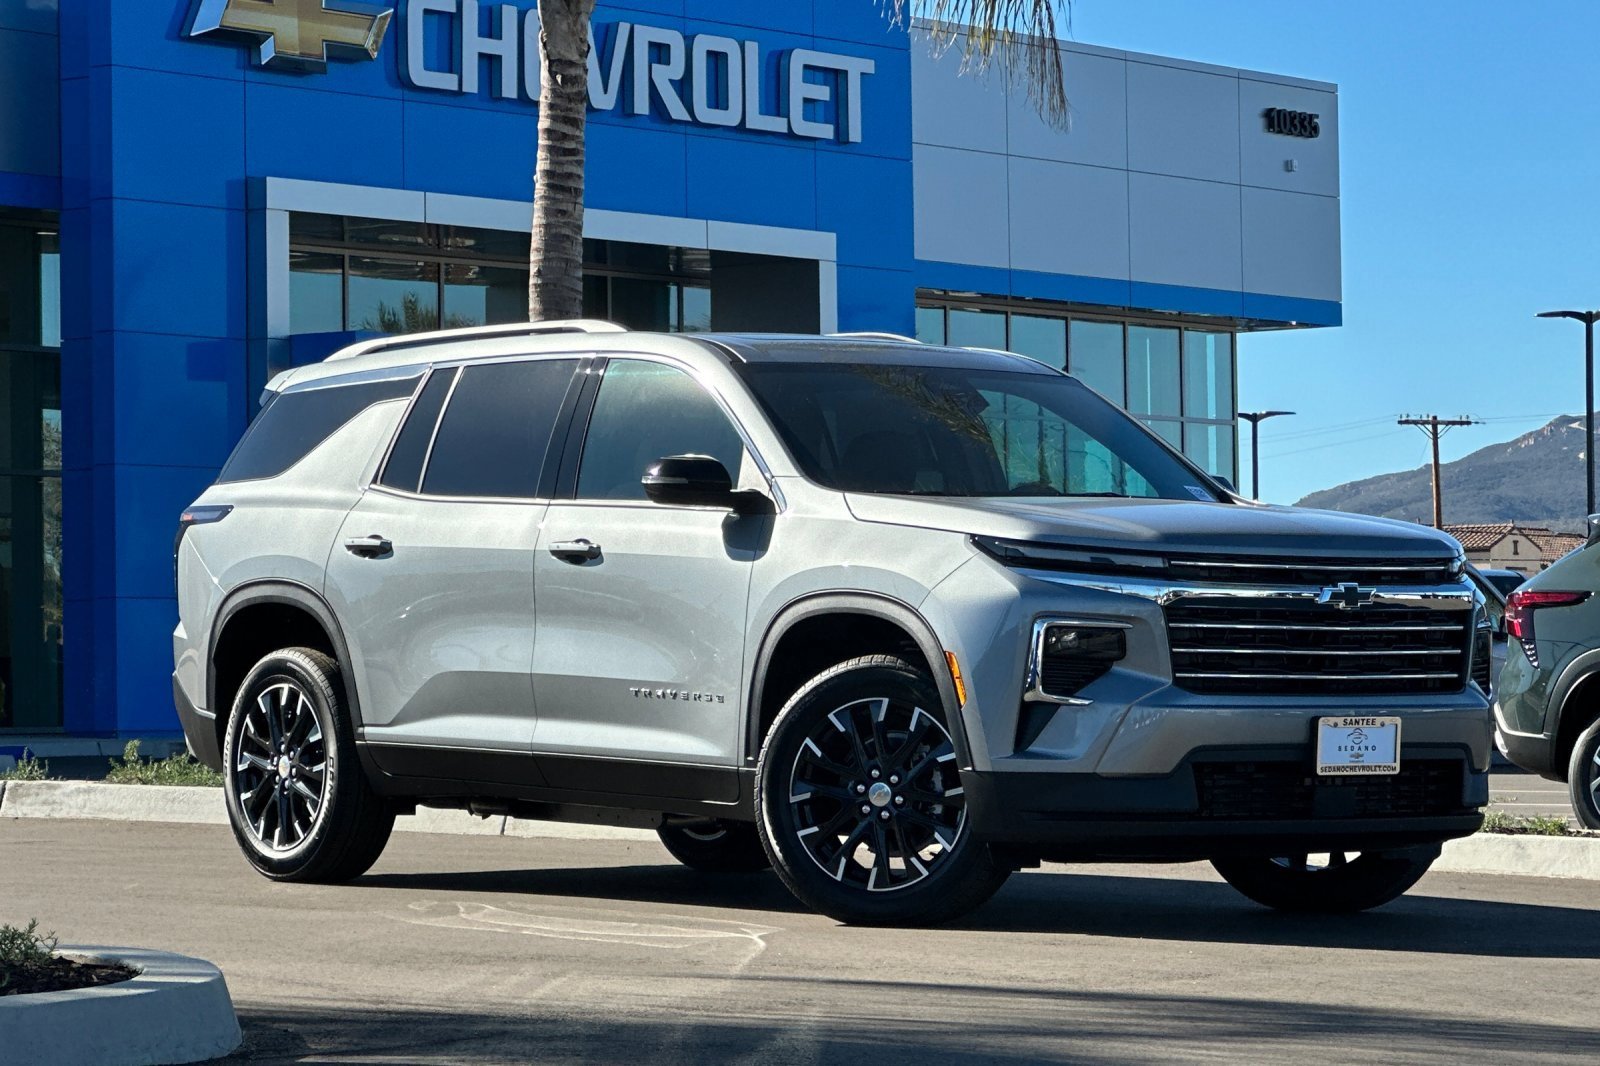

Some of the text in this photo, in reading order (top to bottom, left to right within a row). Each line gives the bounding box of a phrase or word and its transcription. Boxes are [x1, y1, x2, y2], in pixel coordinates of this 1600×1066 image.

[1265, 107, 1320, 138] 10335
[629, 687, 725, 704] TRAVERSE
[1343, 718, 1376, 726] SANTEE
[1320, 765, 1397, 773] SEDANOCHEVROLET.COM
